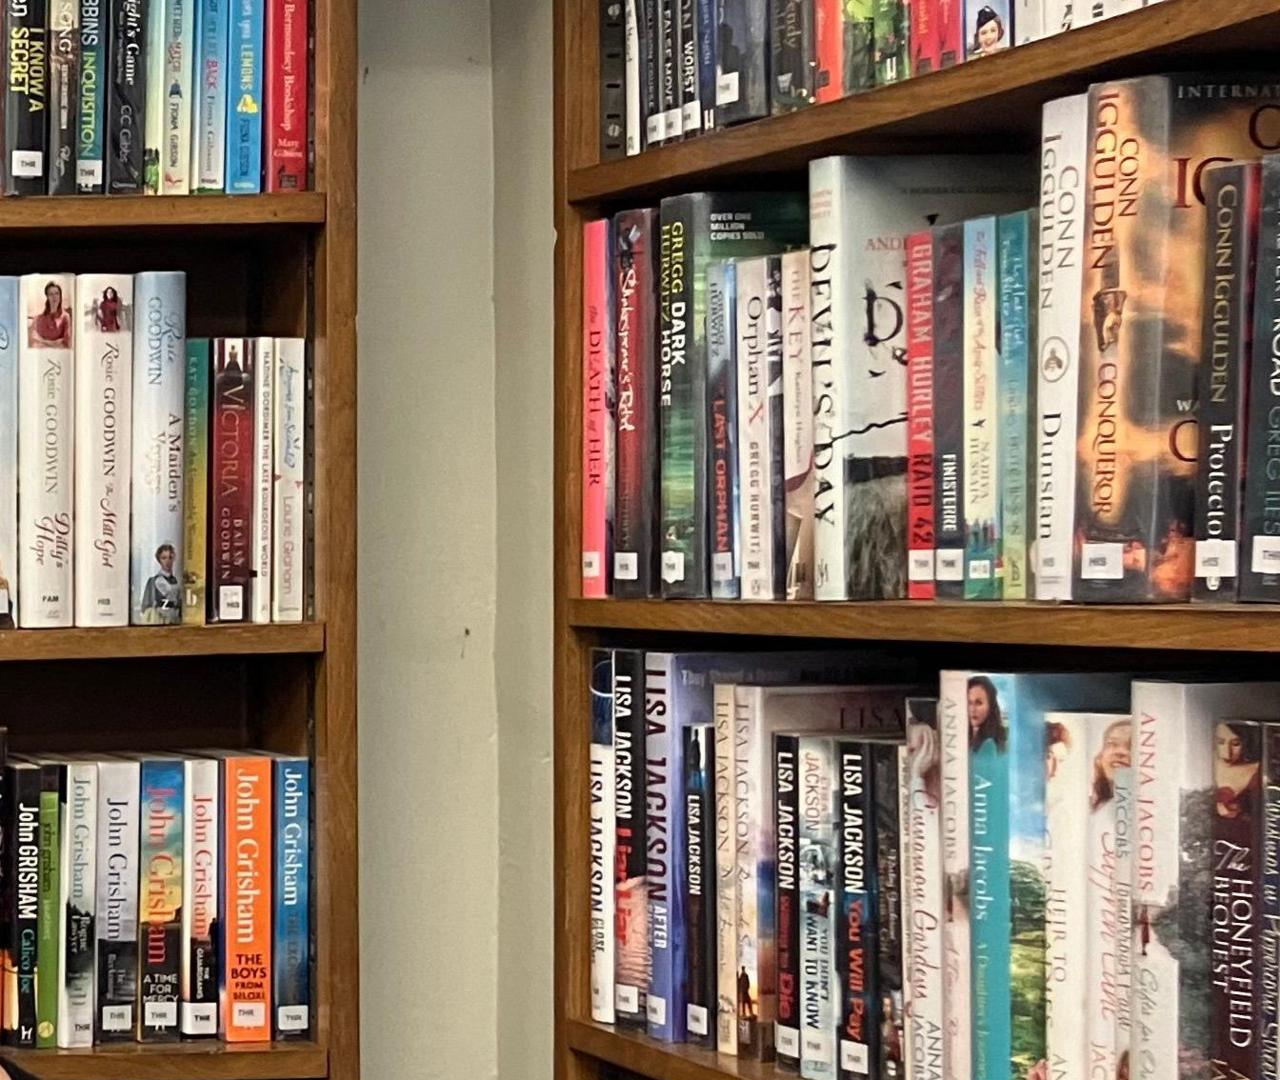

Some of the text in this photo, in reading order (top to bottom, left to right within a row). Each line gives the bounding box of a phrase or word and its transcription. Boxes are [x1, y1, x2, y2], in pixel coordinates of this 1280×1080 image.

[9, 27, 28, 94] SECRET
[29, 37, 45, 96] KNOW
[29, 99, 42, 112] A
[1092, 90, 1119, 269] IGGULDEN
[1118, 138, 1140, 217] CONN
[660, 328, 673, 406] HORSE
[668, 303, 686, 365] DARK
[104, 389, 116, 477] GOODWIN
[167, 413, 182, 512] A Maiden's
[222, 385, 245, 497] VICTORIA
[941, 454, 957, 532] FINISTERRE
[843, 754, 865, 894] LISA JACKSON
[1138, 711, 1157, 893] ANNA JACOBS
[236, 769, 260, 945] John Grisham
[231, 967, 267, 979] BOYS
[237, 953, 263, 966] THE
